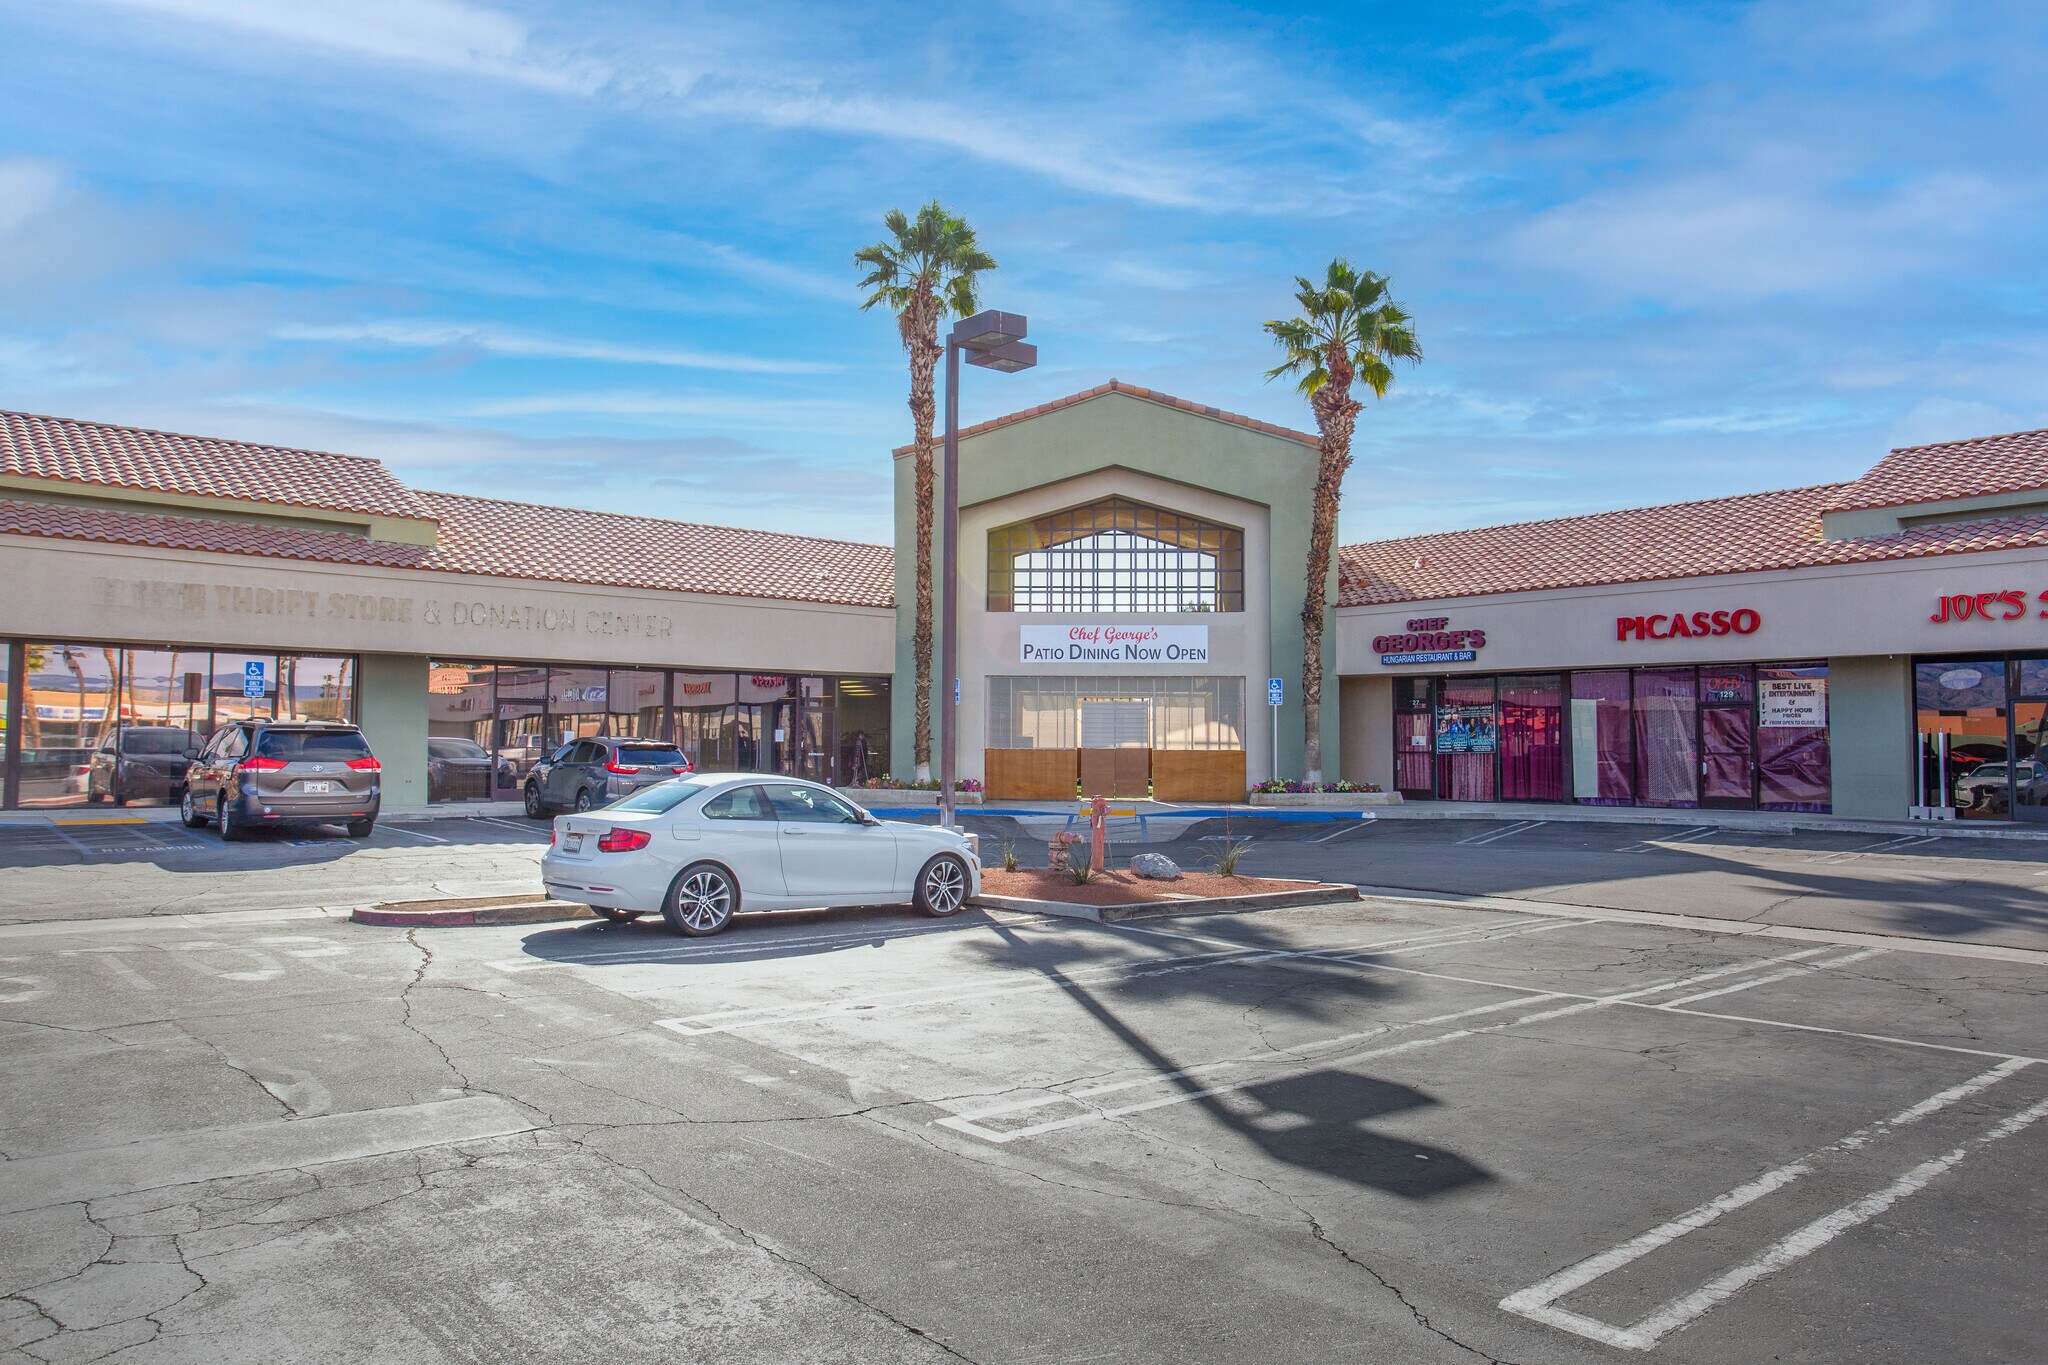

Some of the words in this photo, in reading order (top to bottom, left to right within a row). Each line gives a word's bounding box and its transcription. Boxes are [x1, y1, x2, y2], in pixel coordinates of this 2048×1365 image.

[214, 584, 320, 618] THRIFT
[327, 591, 414, 624] STORE
[423, 600, 441, 625] &
[453, 601, 576, 632] DONATION
[585, 609, 673, 639] CENTER
[1930, 589, 2027, 623] JOE'S
[1406, 617, 1449, 632] CHEF
[1616, 608, 1761, 641] PICASSO
[1069, 626, 1101, 644] Chef
[1104, 626, 1159, 645] George's
[1372, 629, 1487, 654] GEORGE'S
[1383, 654, 1416, 664] HUNGARIAN
[1416, 652, 1454, 662] RESTAURANT
[1454, 652, 1459, 660] &
[1459, 651, 1472, 660] BAR
[1707, 676, 1742, 690] OPEN
[134, 844, 205, 852] PARKING
